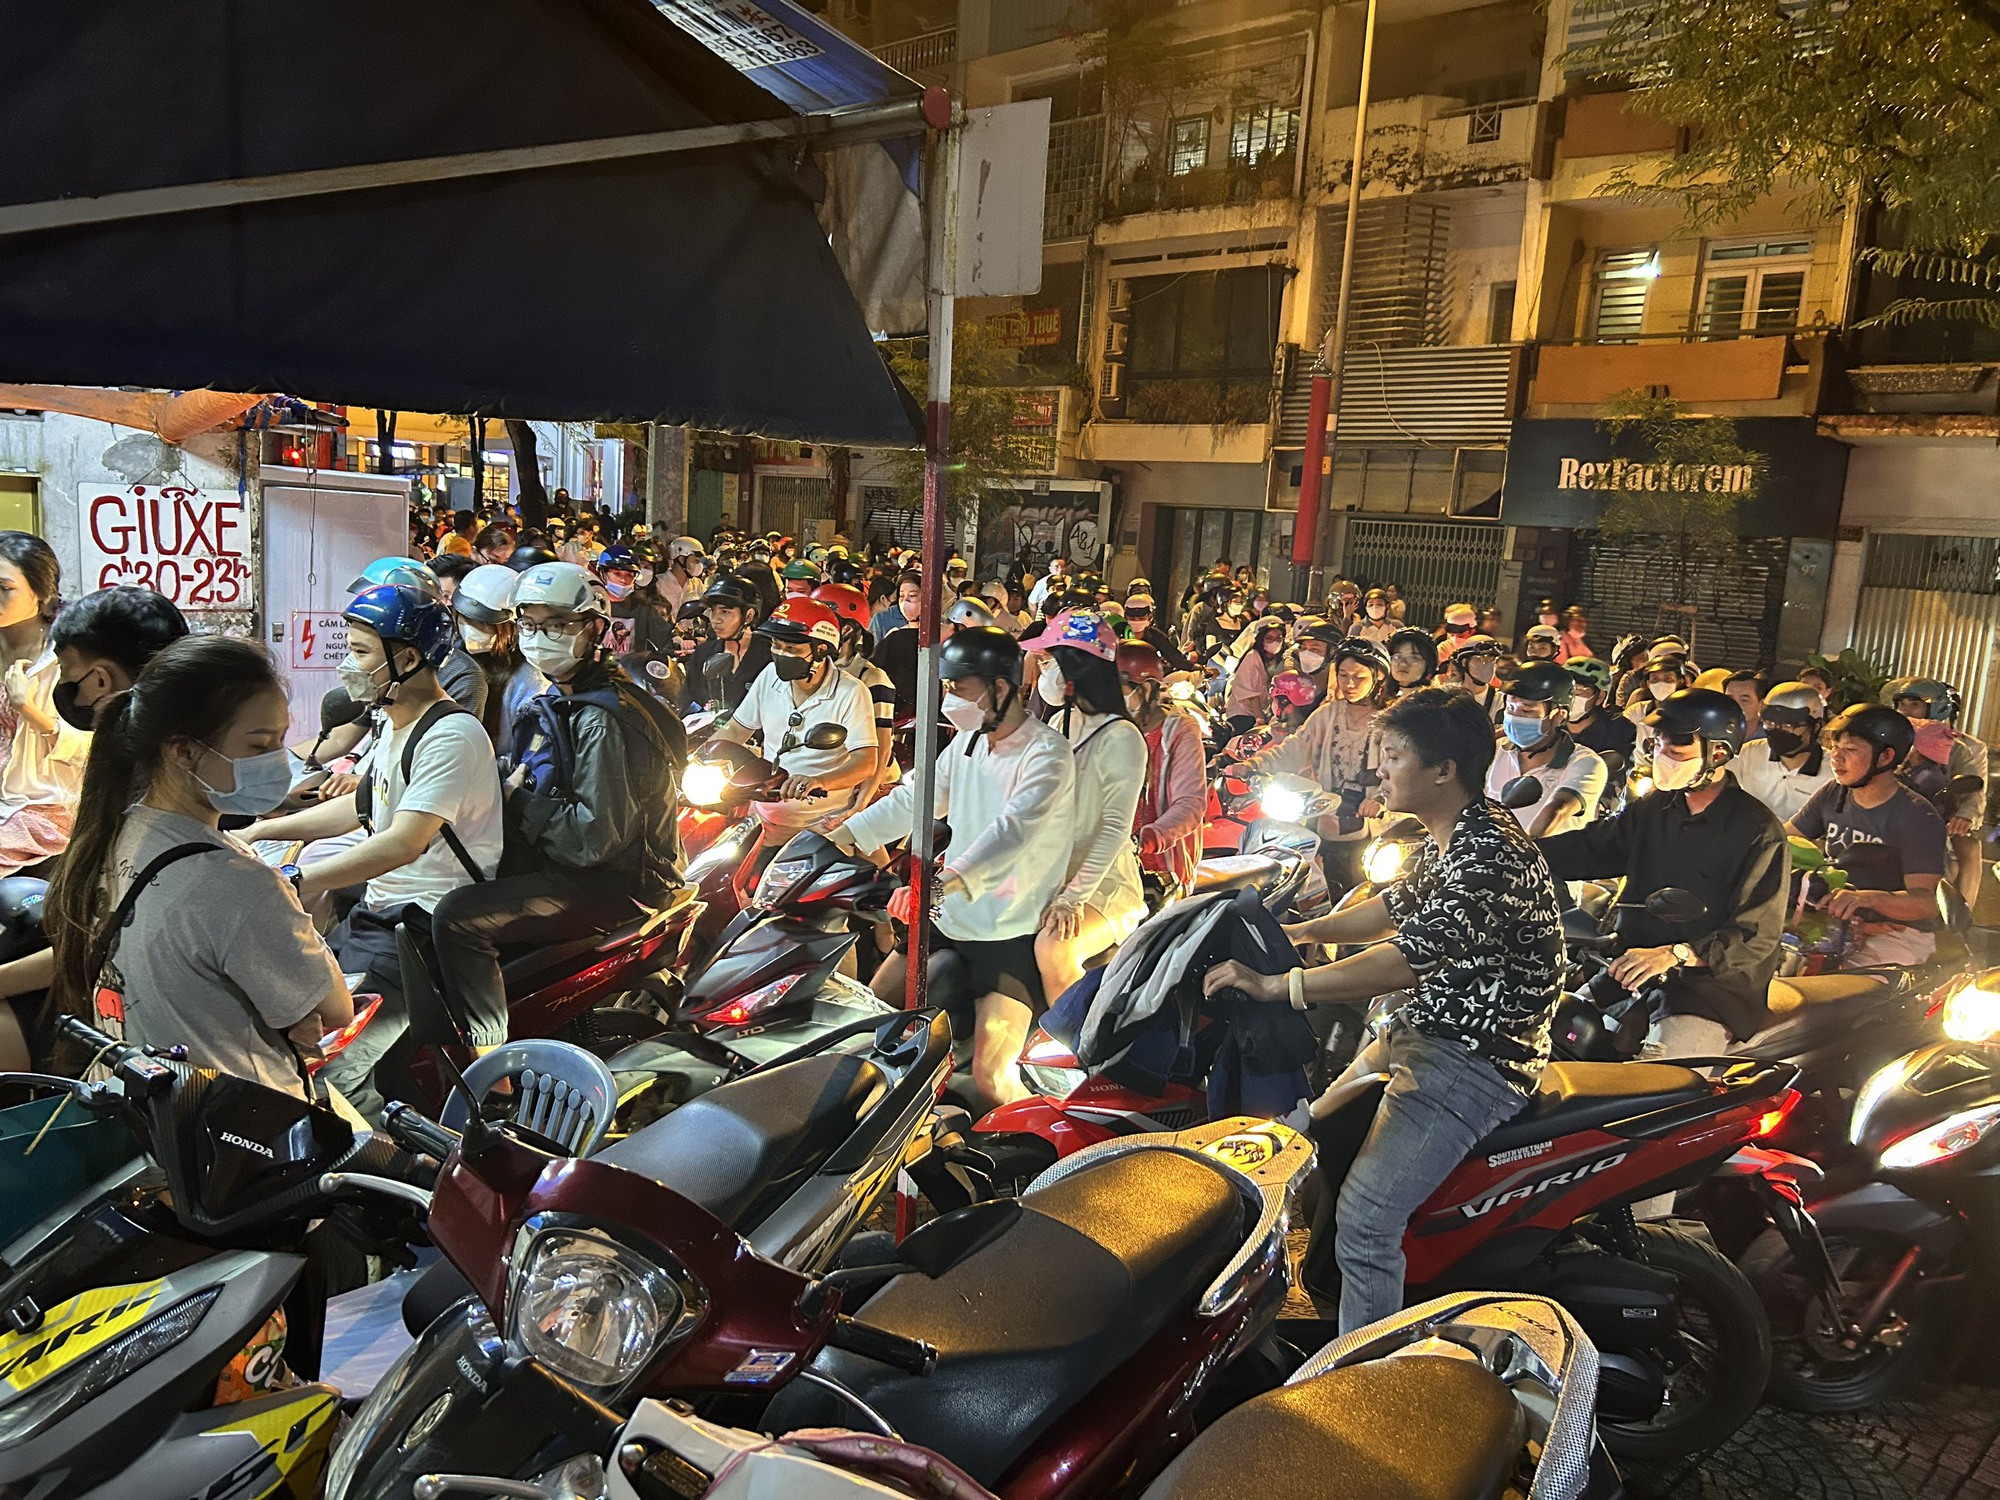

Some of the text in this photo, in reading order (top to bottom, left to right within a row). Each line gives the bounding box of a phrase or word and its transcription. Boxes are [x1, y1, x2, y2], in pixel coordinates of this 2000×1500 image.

[1801, 564, 1817, 577] 97
[319, 618, 350, 630] CẤM LẠ
[324, 651, 344, 660] CHẾT
[1089, 1083, 1126, 1092] HON
[220, 1131, 275, 1159] HONDA
[1460, 1152, 1627, 1218] VARIO
[457, 1355, 489, 1393] HONDA
